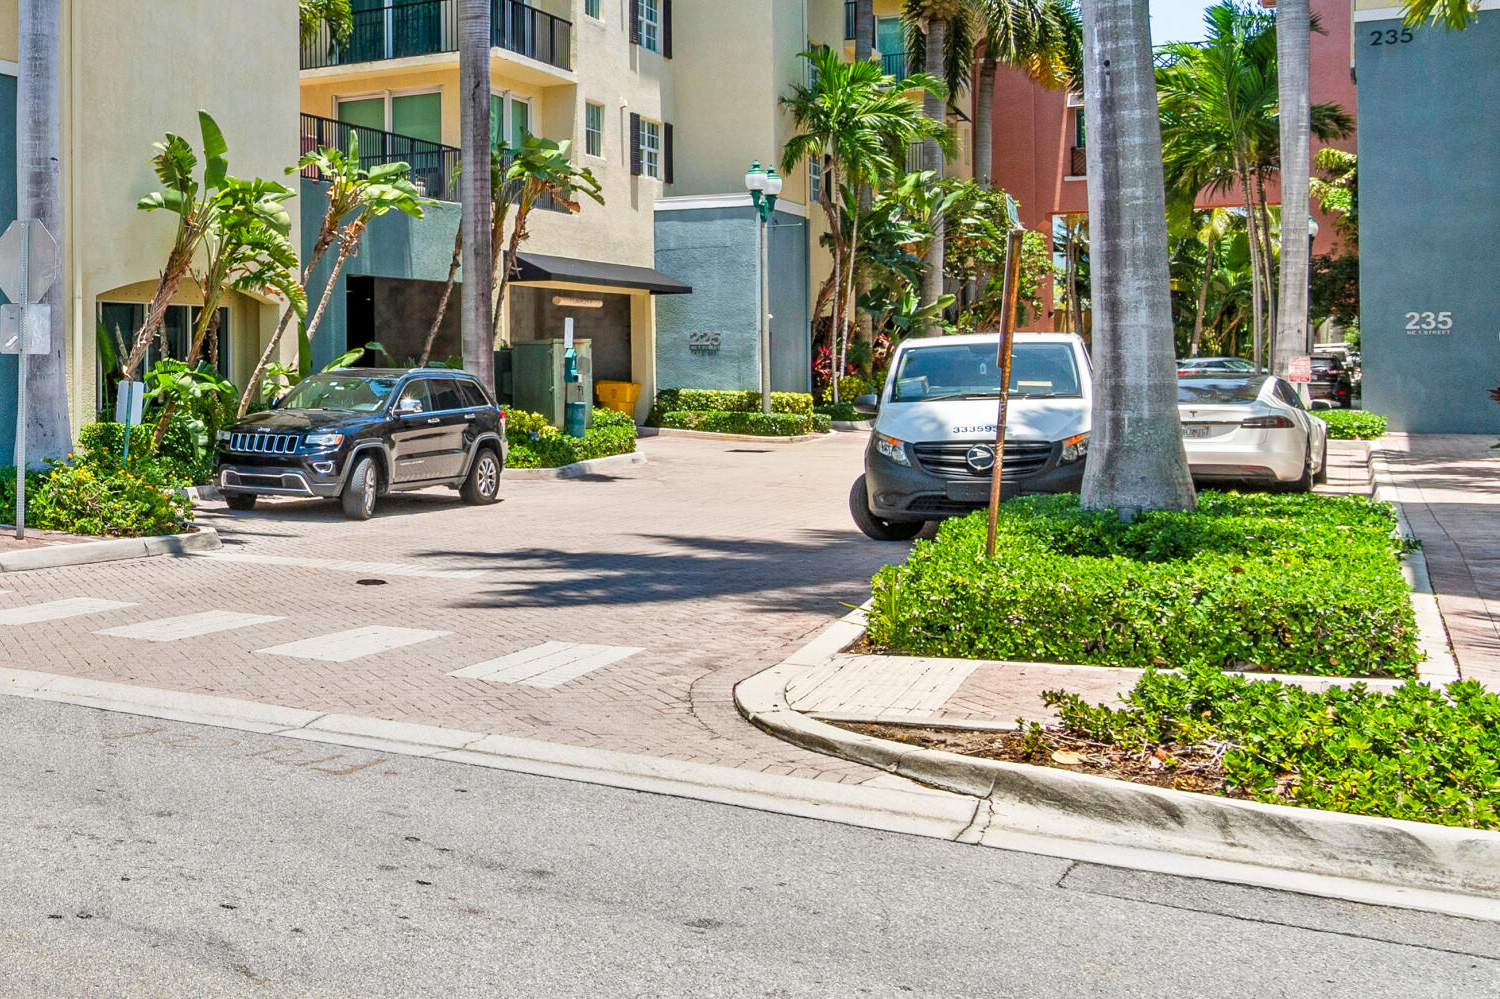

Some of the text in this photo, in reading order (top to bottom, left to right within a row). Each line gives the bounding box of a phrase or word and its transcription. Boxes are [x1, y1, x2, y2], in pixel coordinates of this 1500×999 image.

[1370, 28, 1413, 46] 235
[1405, 312, 1453, 330] 235
[690, 331, 722, 346] 225
